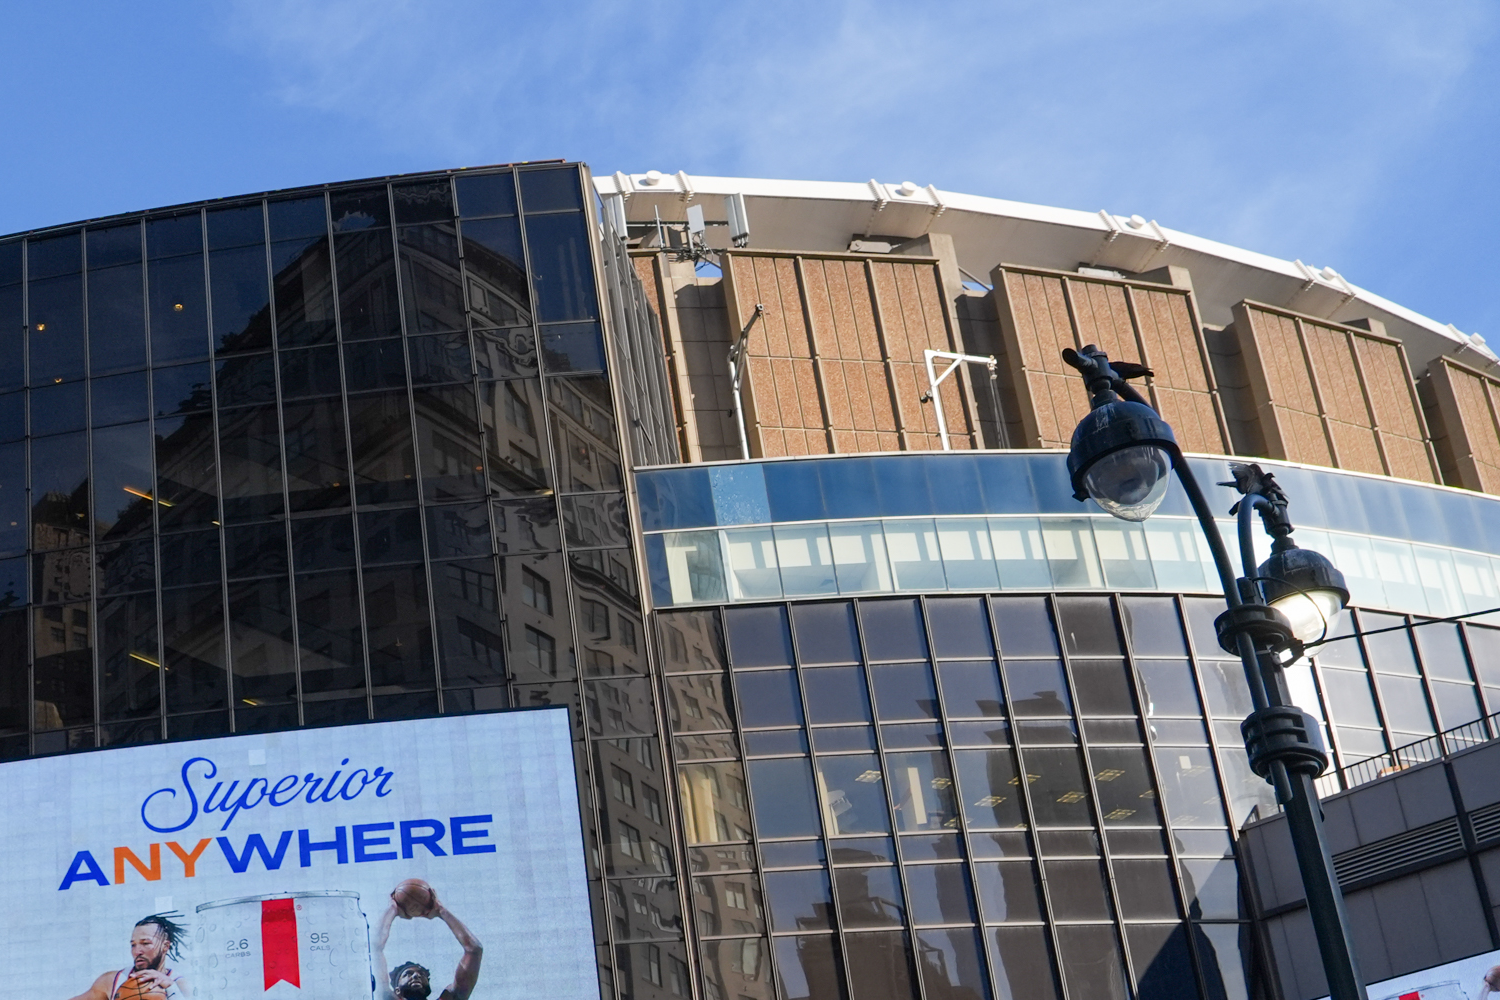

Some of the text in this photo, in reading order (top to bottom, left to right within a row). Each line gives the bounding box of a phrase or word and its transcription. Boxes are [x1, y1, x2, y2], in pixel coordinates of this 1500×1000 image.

[141, 757, 394, 833] Superior
[58, 814, 497, 891] ANYWHERE
[226, 937, 250, 951] 2.6
[309, 932, 330, 944] 95
[225, 950, 251, 959] CARBS
